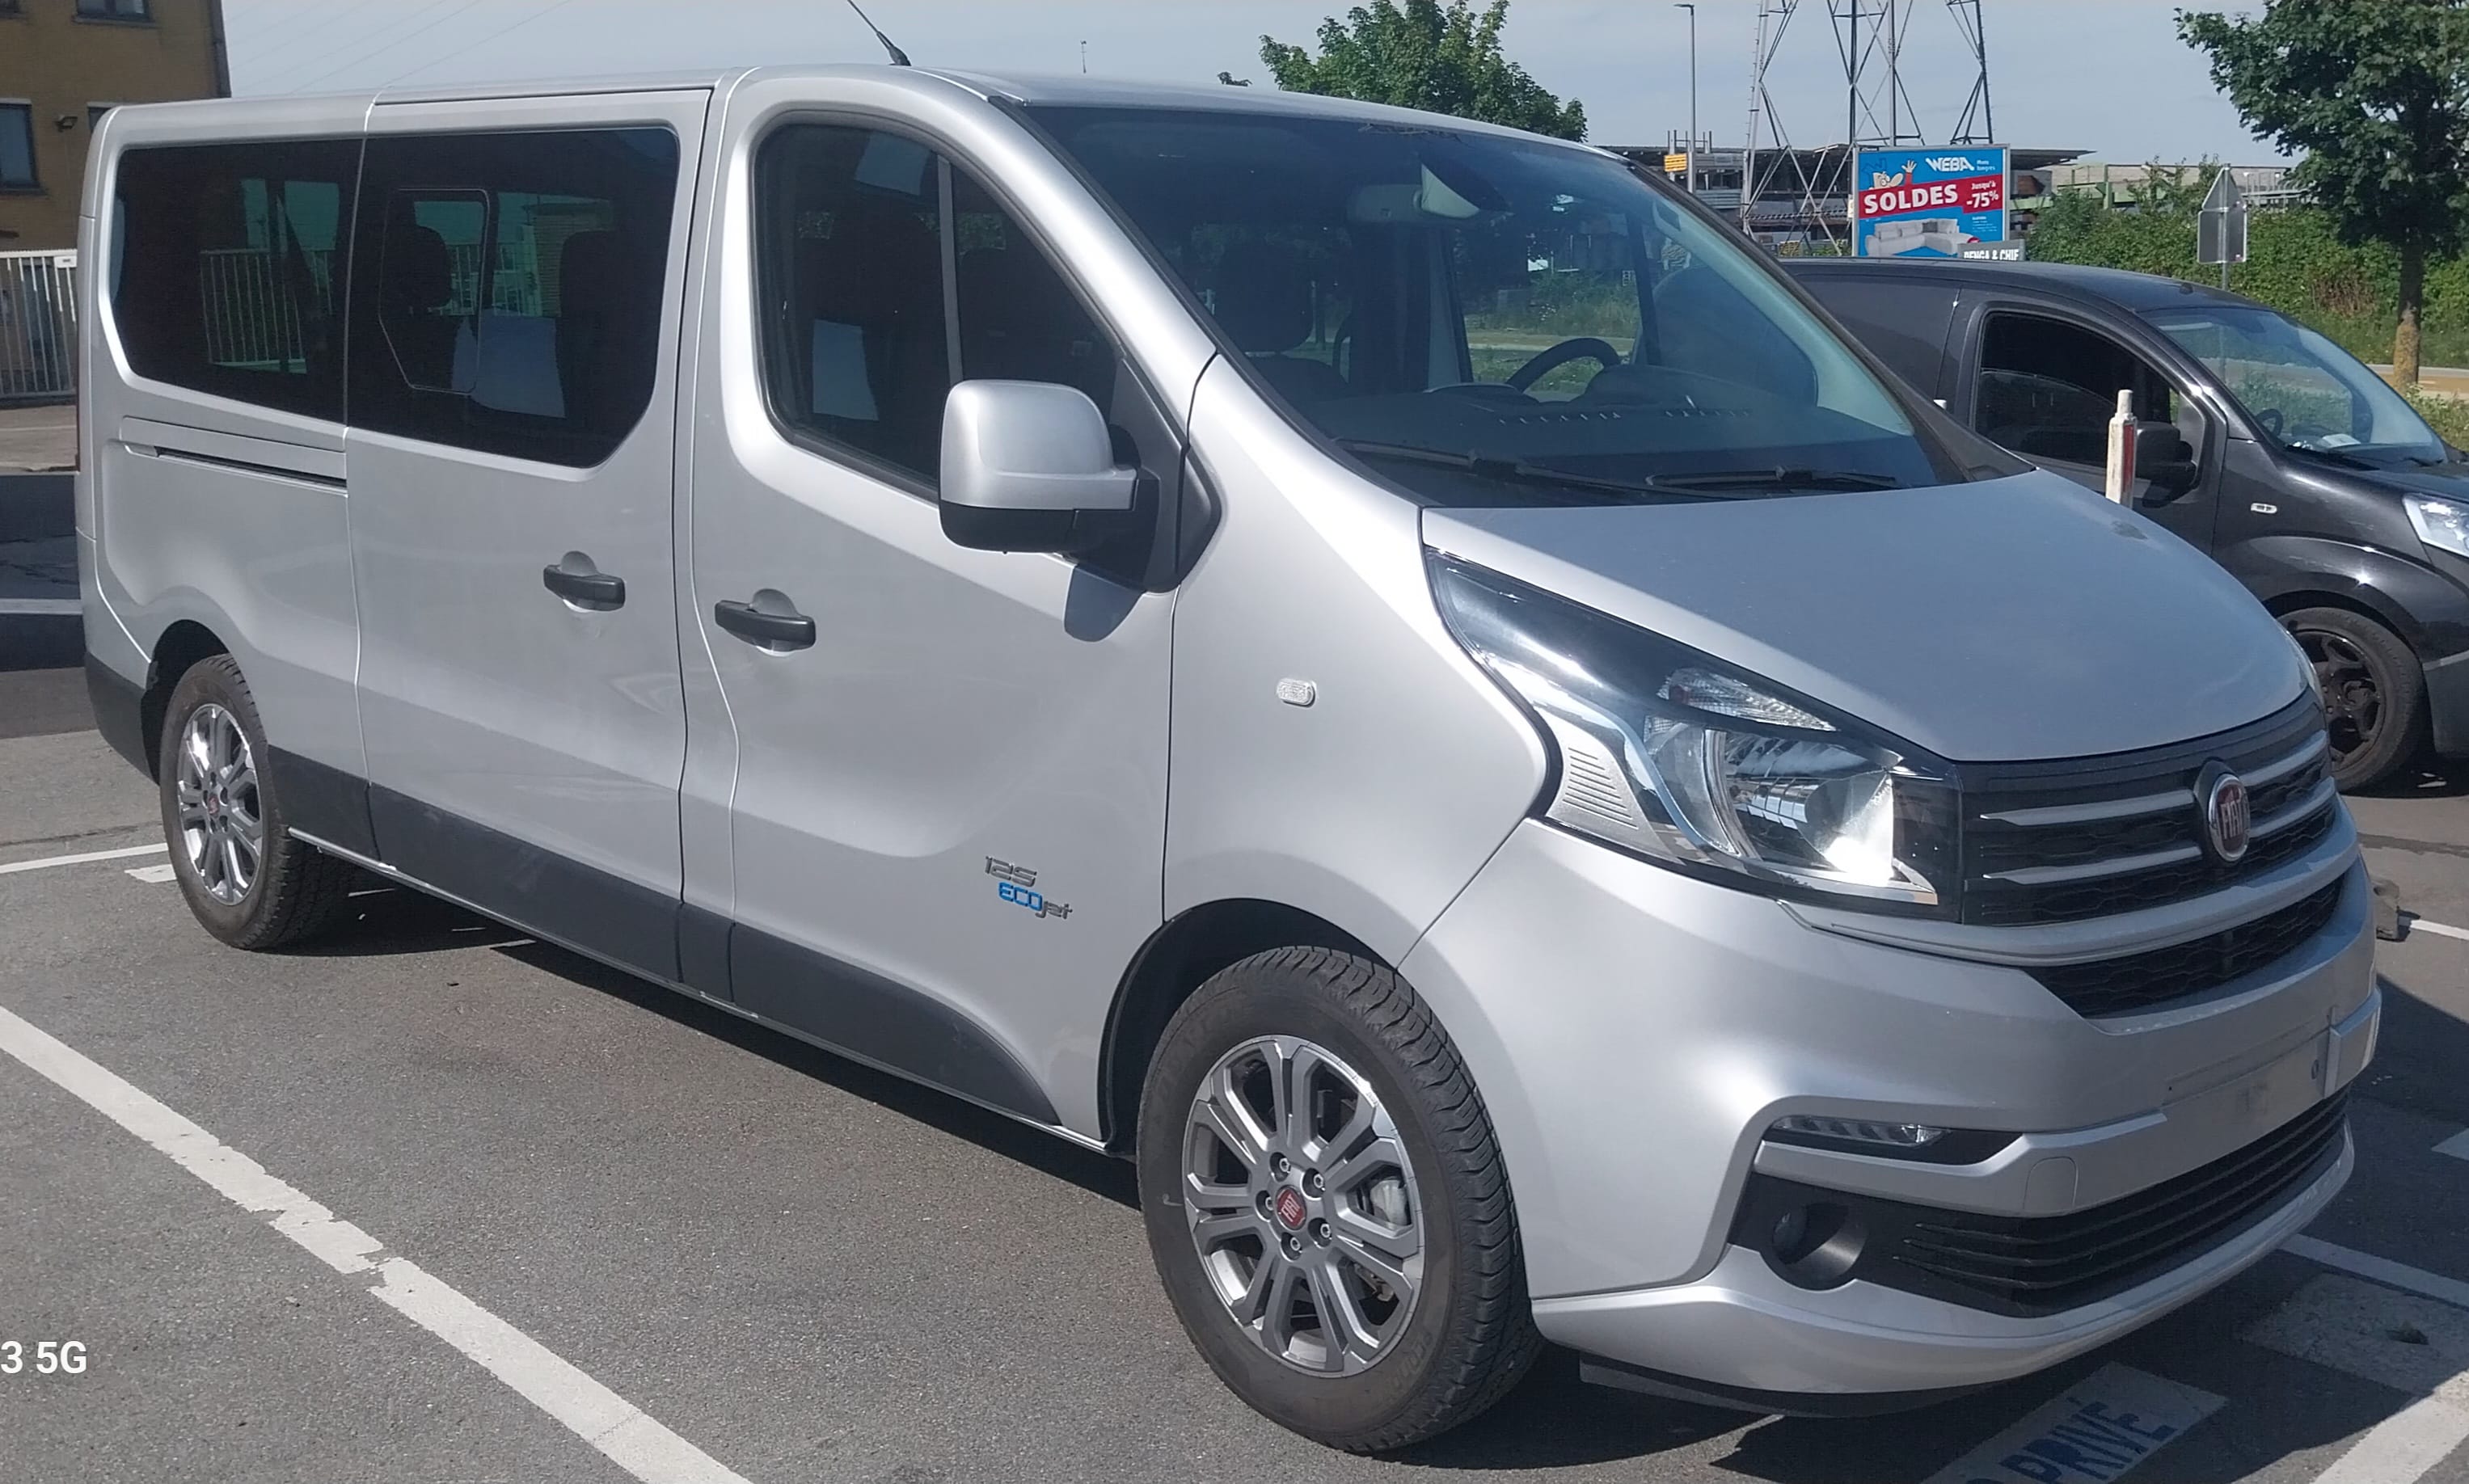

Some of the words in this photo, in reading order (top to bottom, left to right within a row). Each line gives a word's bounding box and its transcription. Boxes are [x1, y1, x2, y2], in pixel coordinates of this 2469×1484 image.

[1925, 157, 1975, 171] WEBA
[1863, 183, 1958, 214] SOLDES
[1966, 190, 1999, 209] -75%
[2219, 799, 2244, 840] FIAT
[985, 856, 1037, 887] 125
[1280, 1193, 1301, 1223] FIAT
